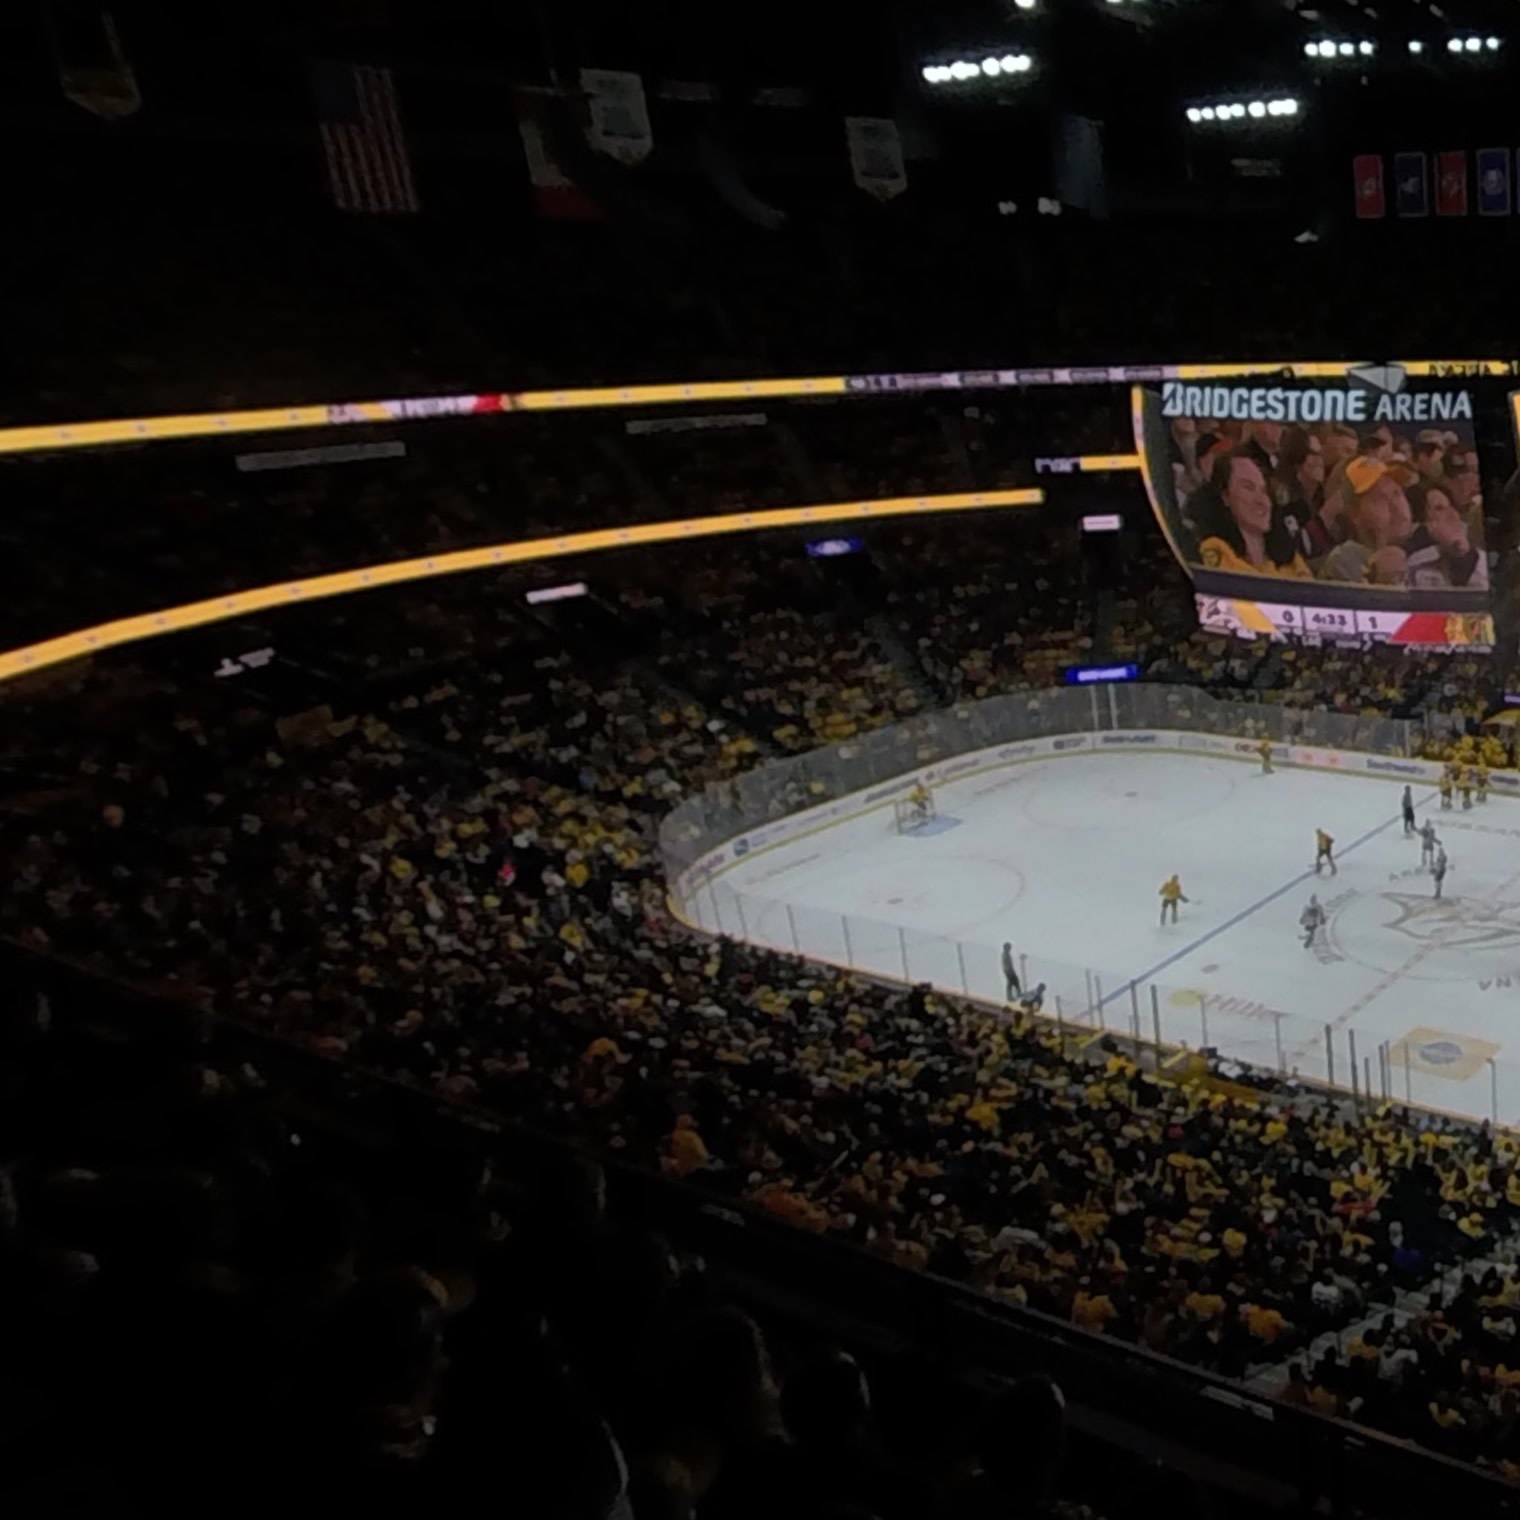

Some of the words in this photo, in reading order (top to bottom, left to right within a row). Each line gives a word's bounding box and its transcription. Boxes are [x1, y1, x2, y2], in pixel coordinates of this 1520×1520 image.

[1162, 382, 1367, 421] BRIDGESTONE
[1374, 389, 1473, 421] ARENA
[1282, 610, 1294, 624] 0
[1368, 616, 1378, 629] 1
